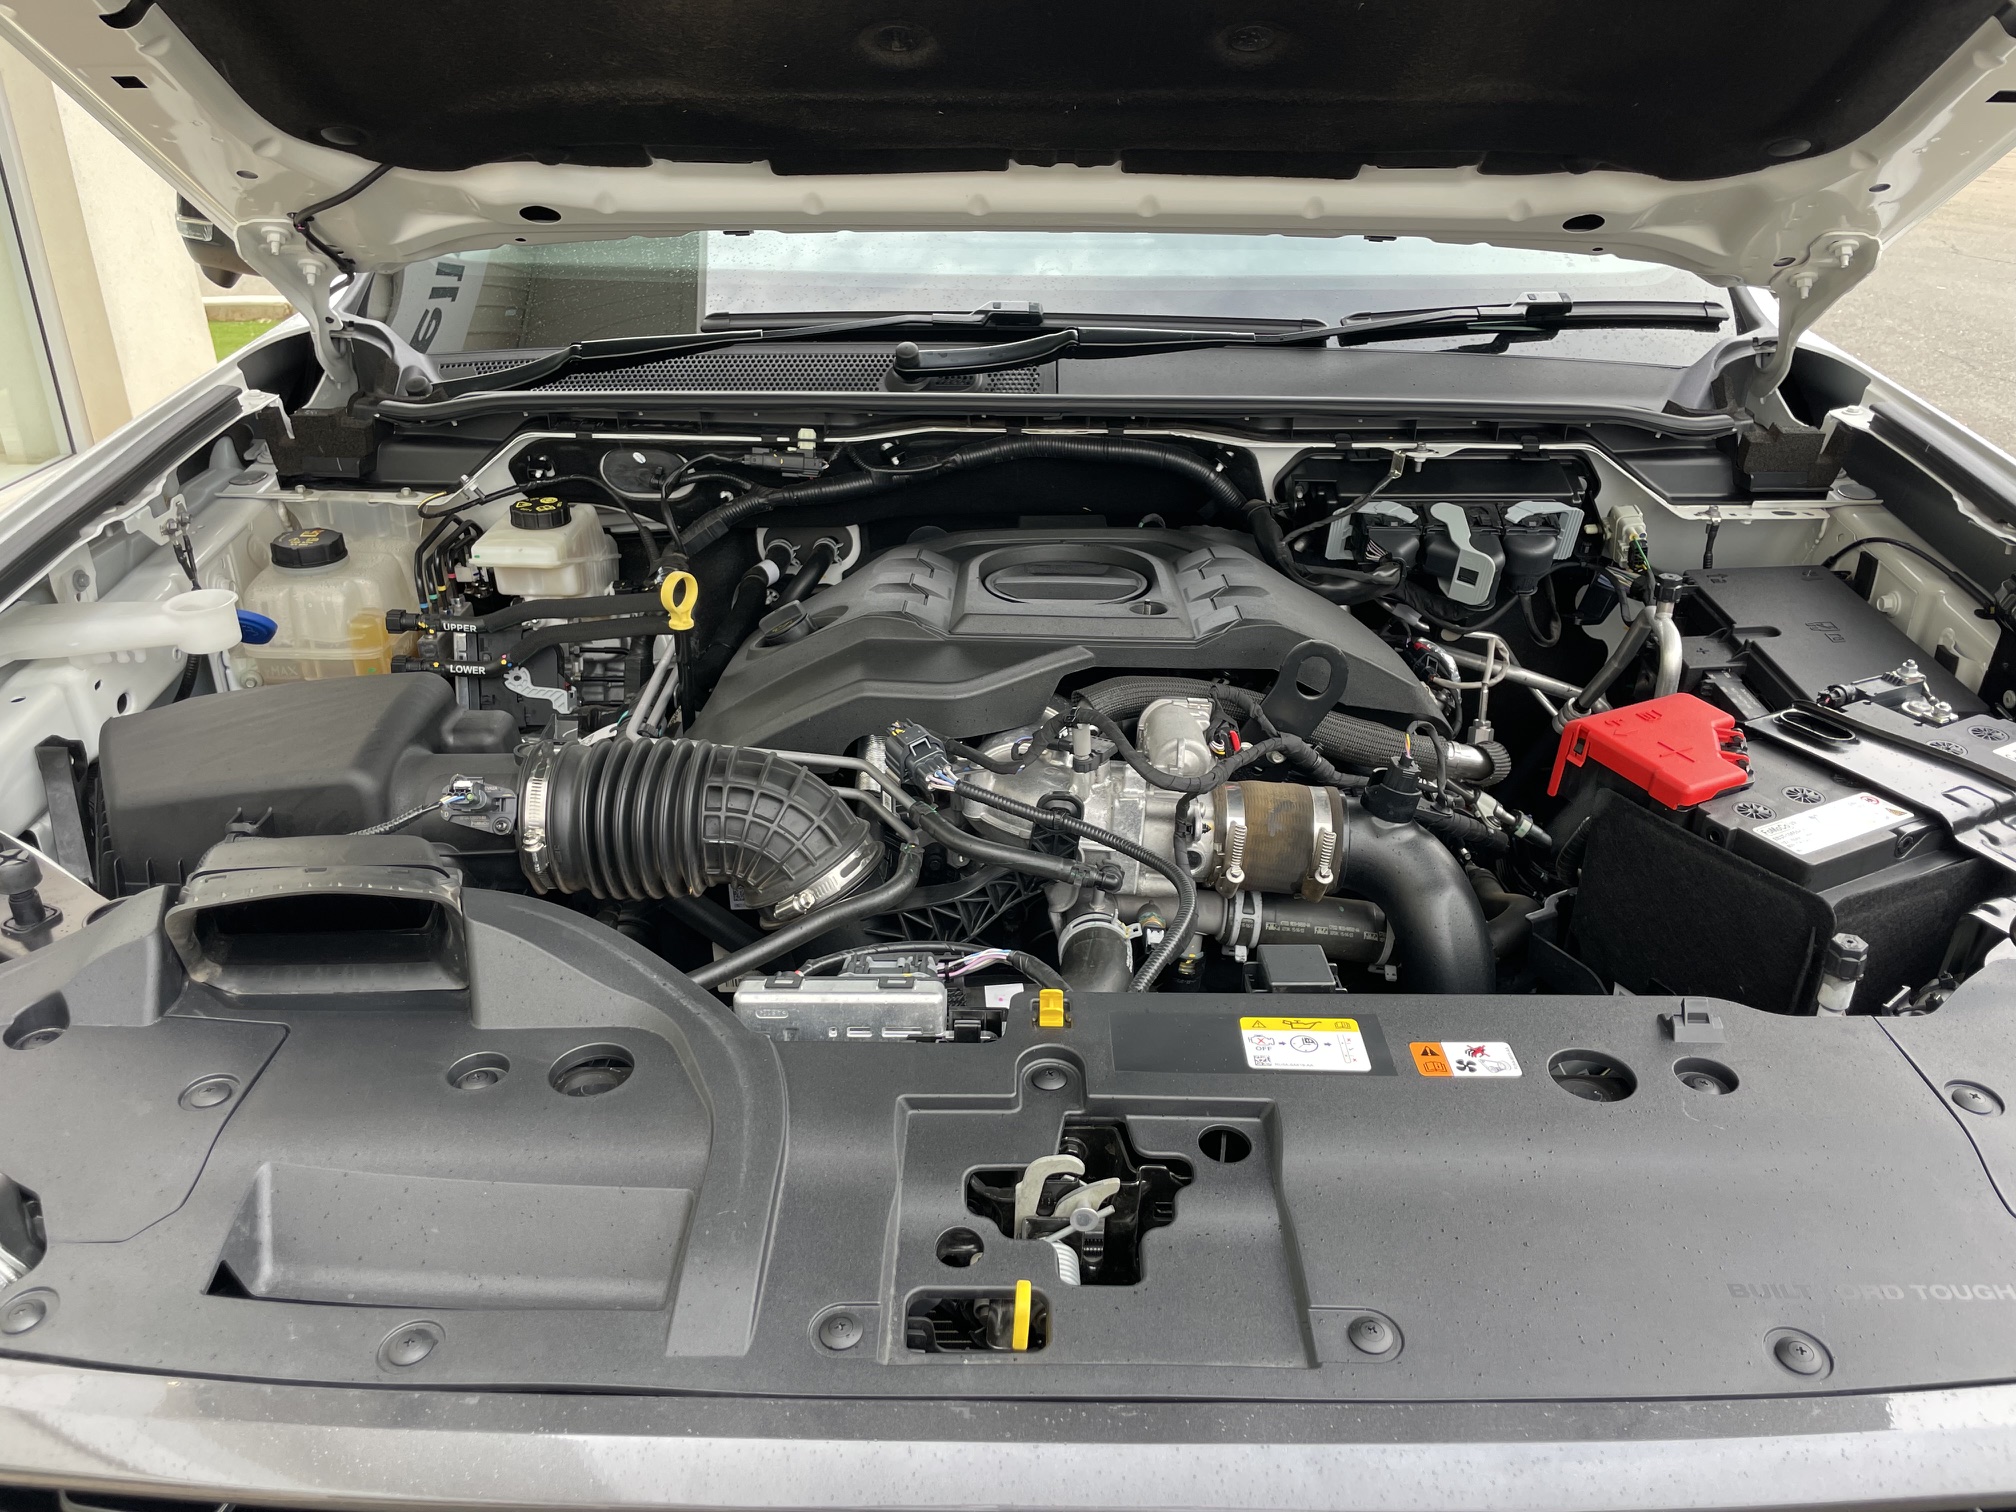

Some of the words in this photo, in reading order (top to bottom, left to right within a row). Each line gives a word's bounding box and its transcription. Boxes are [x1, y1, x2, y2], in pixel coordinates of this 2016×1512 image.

[442, 621, 478, 634] UPPER
[270, 664, 299, 676] MAX
[449, 663, 486, 676] LOWER
[1726, 1283, 1811, 1300] BUILT
[1822, 1283, 1905, 1300] ORD
[1909, 1284, 2016, 1300] TOUGH
